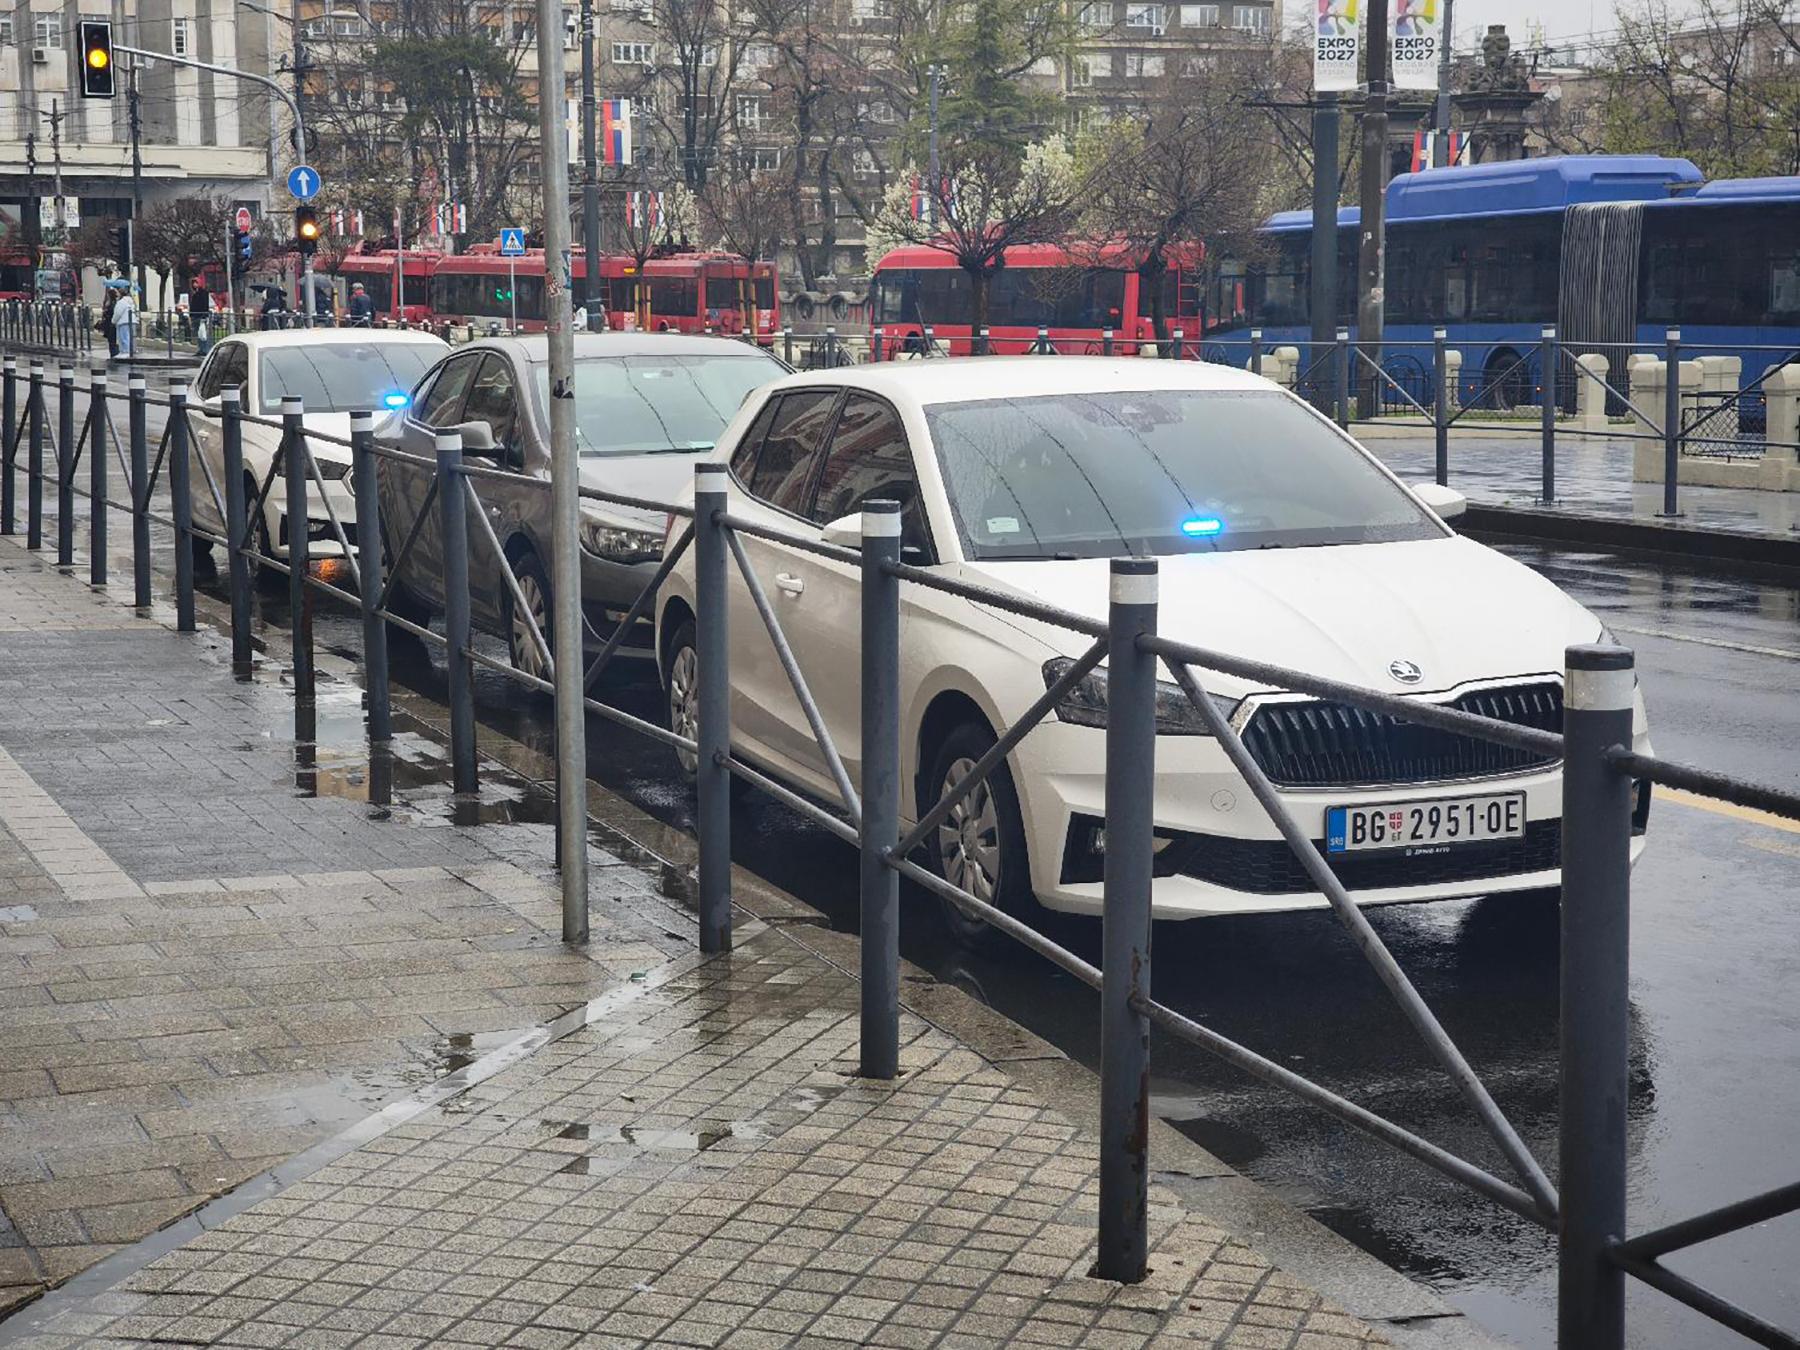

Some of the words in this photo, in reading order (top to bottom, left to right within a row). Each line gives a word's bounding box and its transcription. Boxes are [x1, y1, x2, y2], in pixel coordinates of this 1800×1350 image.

[1317, 37, 1355, 48] EXPO
[1395, 37, 1434, 48] EXPO
[1317, 50, 1355, 60] 2027
[1395, 50, 1434, 60] 2027
[1352, 810, 1386, 844] BG
